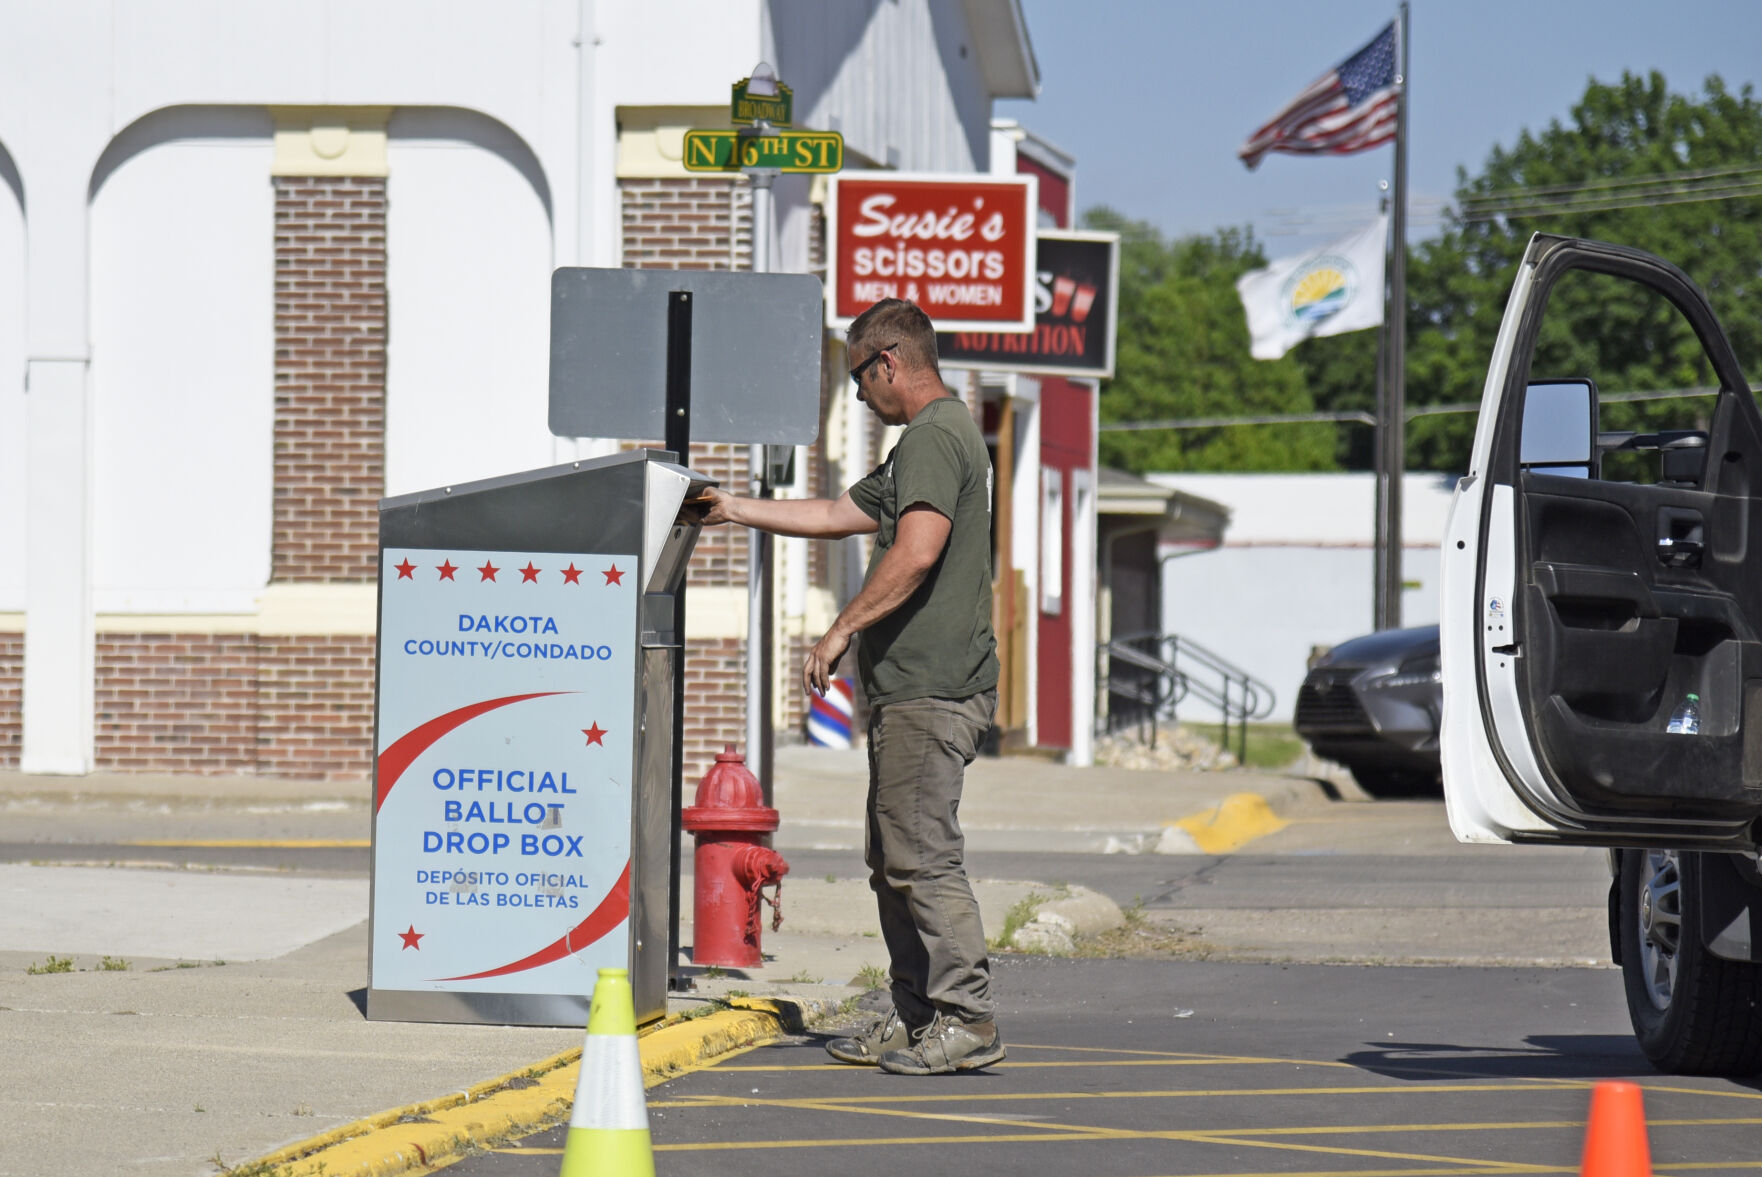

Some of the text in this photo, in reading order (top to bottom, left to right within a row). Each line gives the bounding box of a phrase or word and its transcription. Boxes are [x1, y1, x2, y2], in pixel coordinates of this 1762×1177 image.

[738, 101, 786, 121] BROADWAY
[690, 137, 837, 168] N 16TH ST
[853, 193, 1004, 240] Susie's
[853, 242, 1004, 280] scissors
[854, 282, 898, 303] MEN
[927, 284, 1003, 306] WOMEN
[458, 614, 559, 634] DAKOTA
[404, 639, 612, 661] COUNTY/CONDADO
[432, 768, 577, 794] OFFICIAL
[444, 800, 565, 825] BALLOT
[423, 831, 584, 857] DROP BOX
[416, 868, 589, 888] DEPÓSITO OFICIAL
[425, 891, 579, 909] DE LAS BOLETAS
